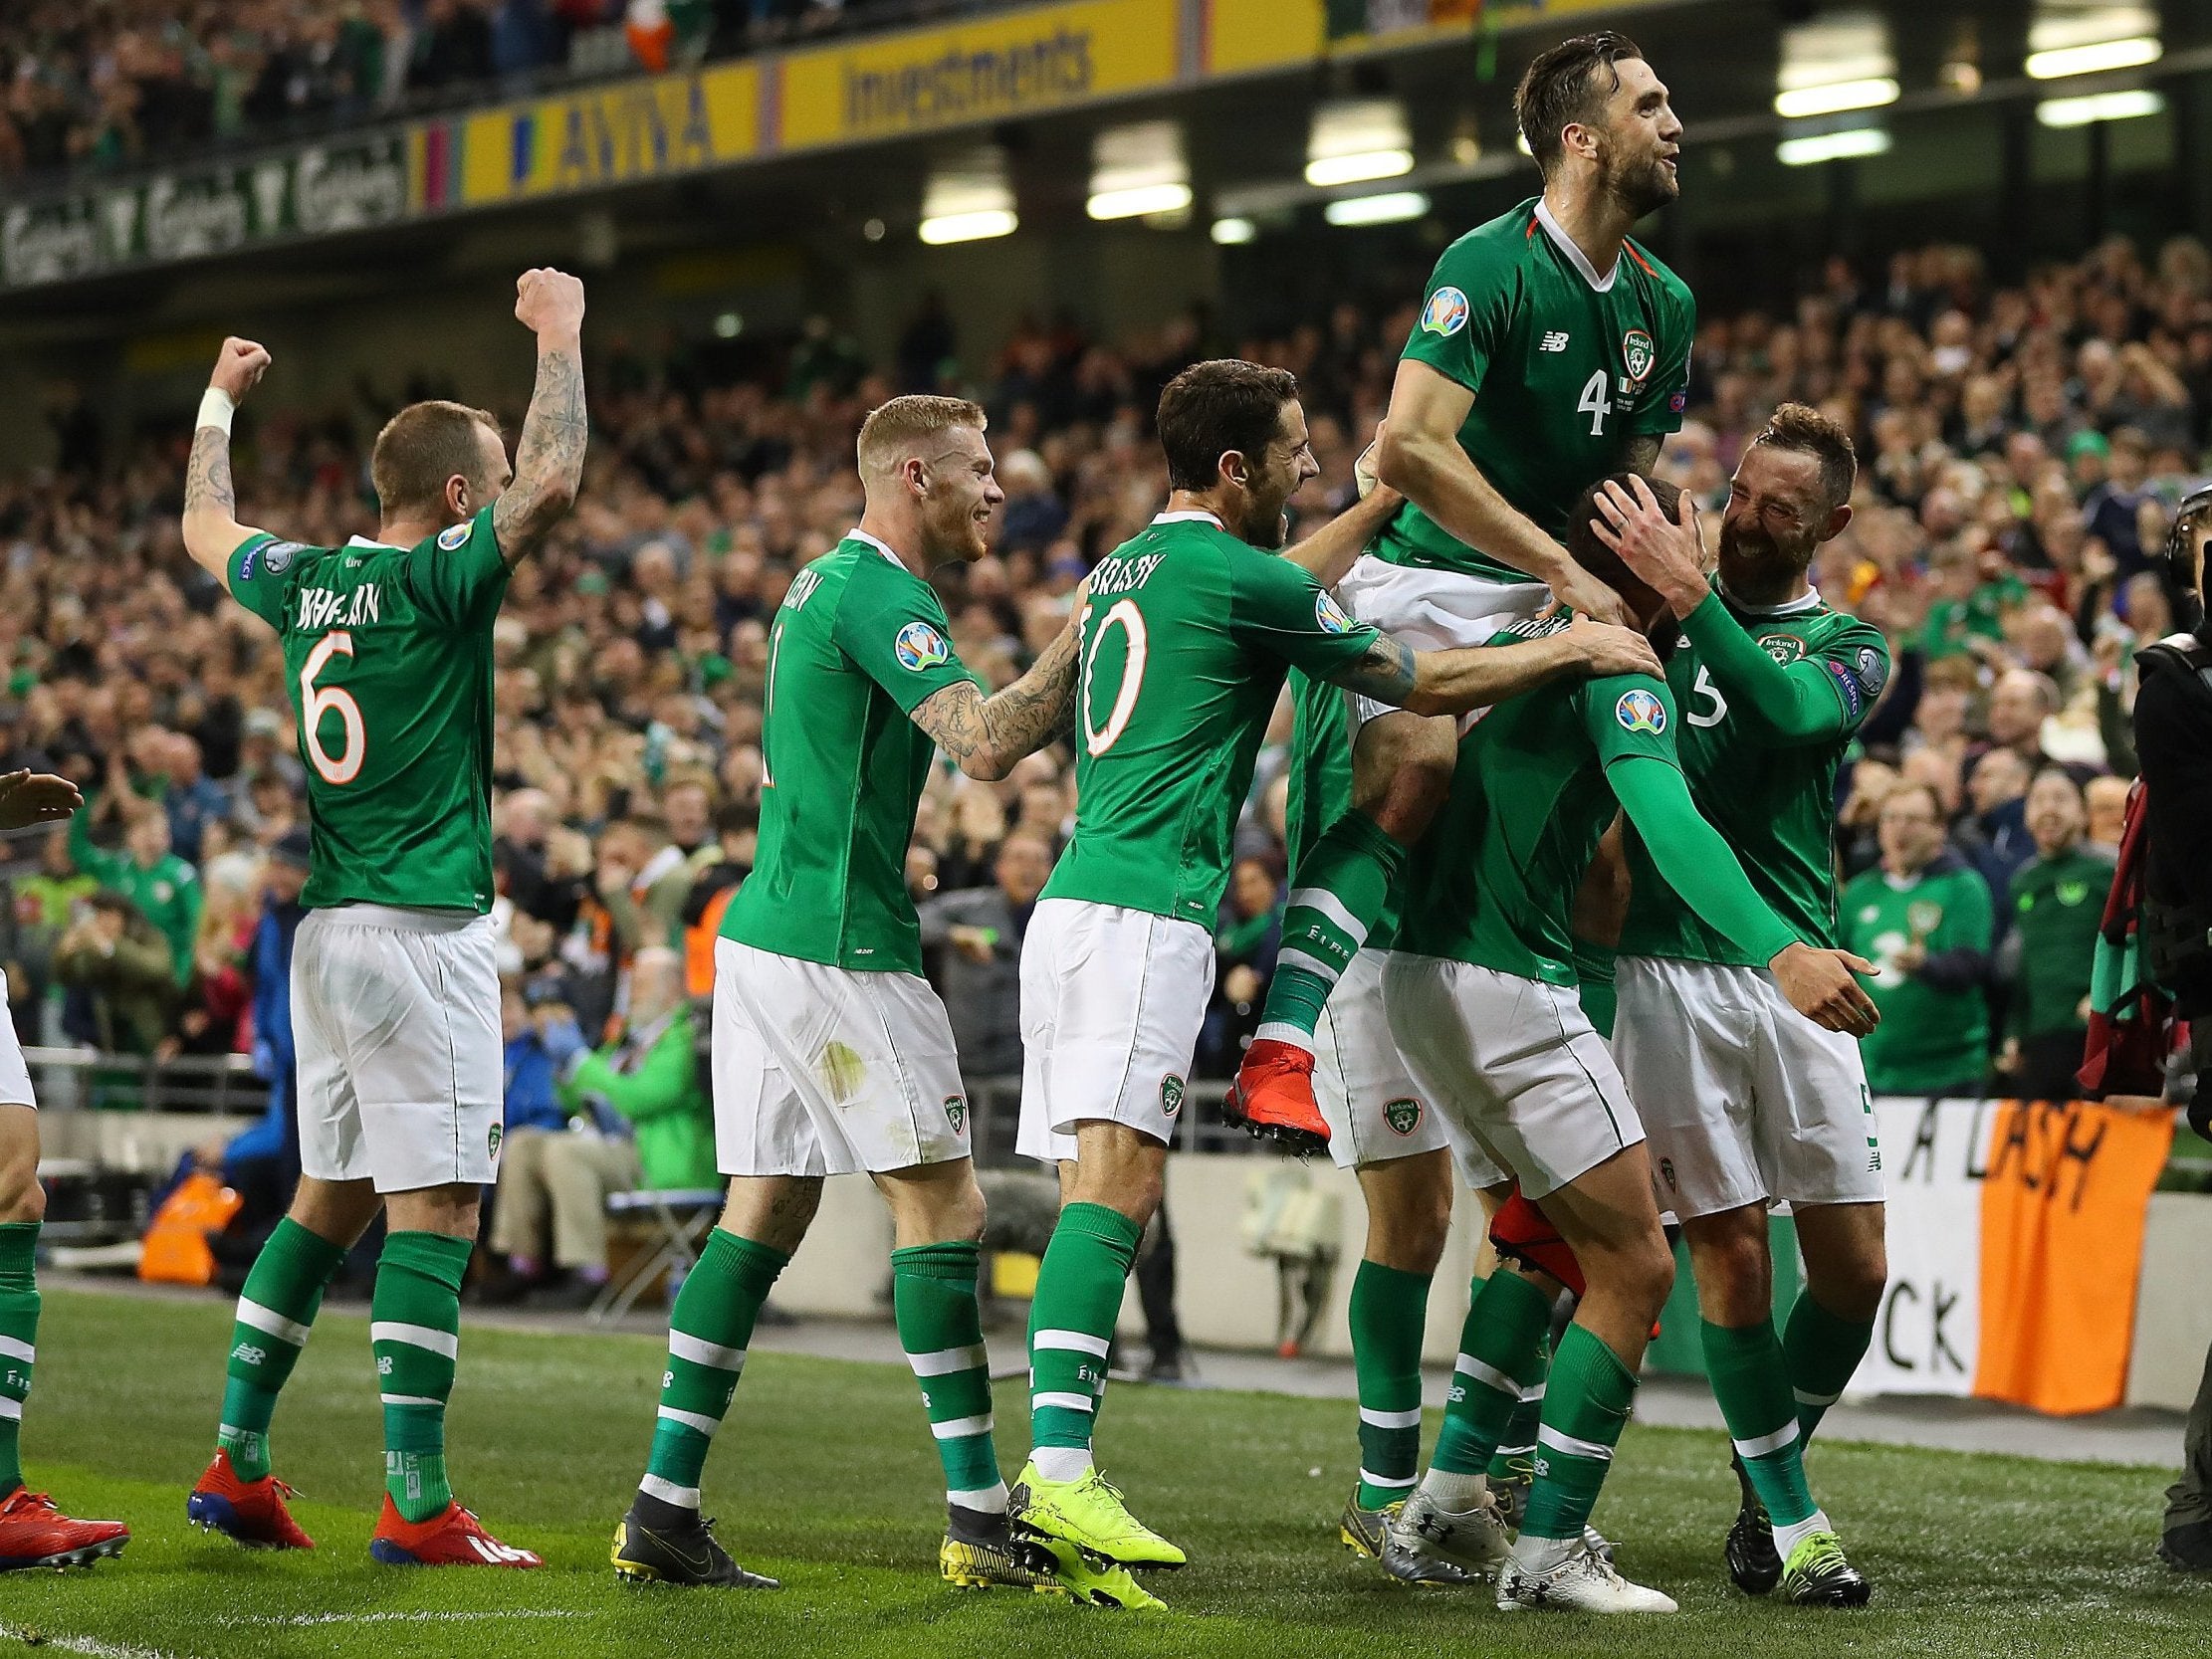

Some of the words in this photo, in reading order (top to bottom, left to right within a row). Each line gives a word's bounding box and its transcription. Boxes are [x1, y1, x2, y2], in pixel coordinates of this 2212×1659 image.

[1577, 368, 1611, 436] 4
[1089, 553, 1167, 596] BRADY
[1766, 638, 1797, 649] Ireland
[301, 630, 366, 785] 6
[1686, 664, 1728, 727] 5
[1841, 673, 1858, 716] RESPECT
[1901, 1096, 1938, 1184] A
[1966, 1096, 2106, 1215] LASH
